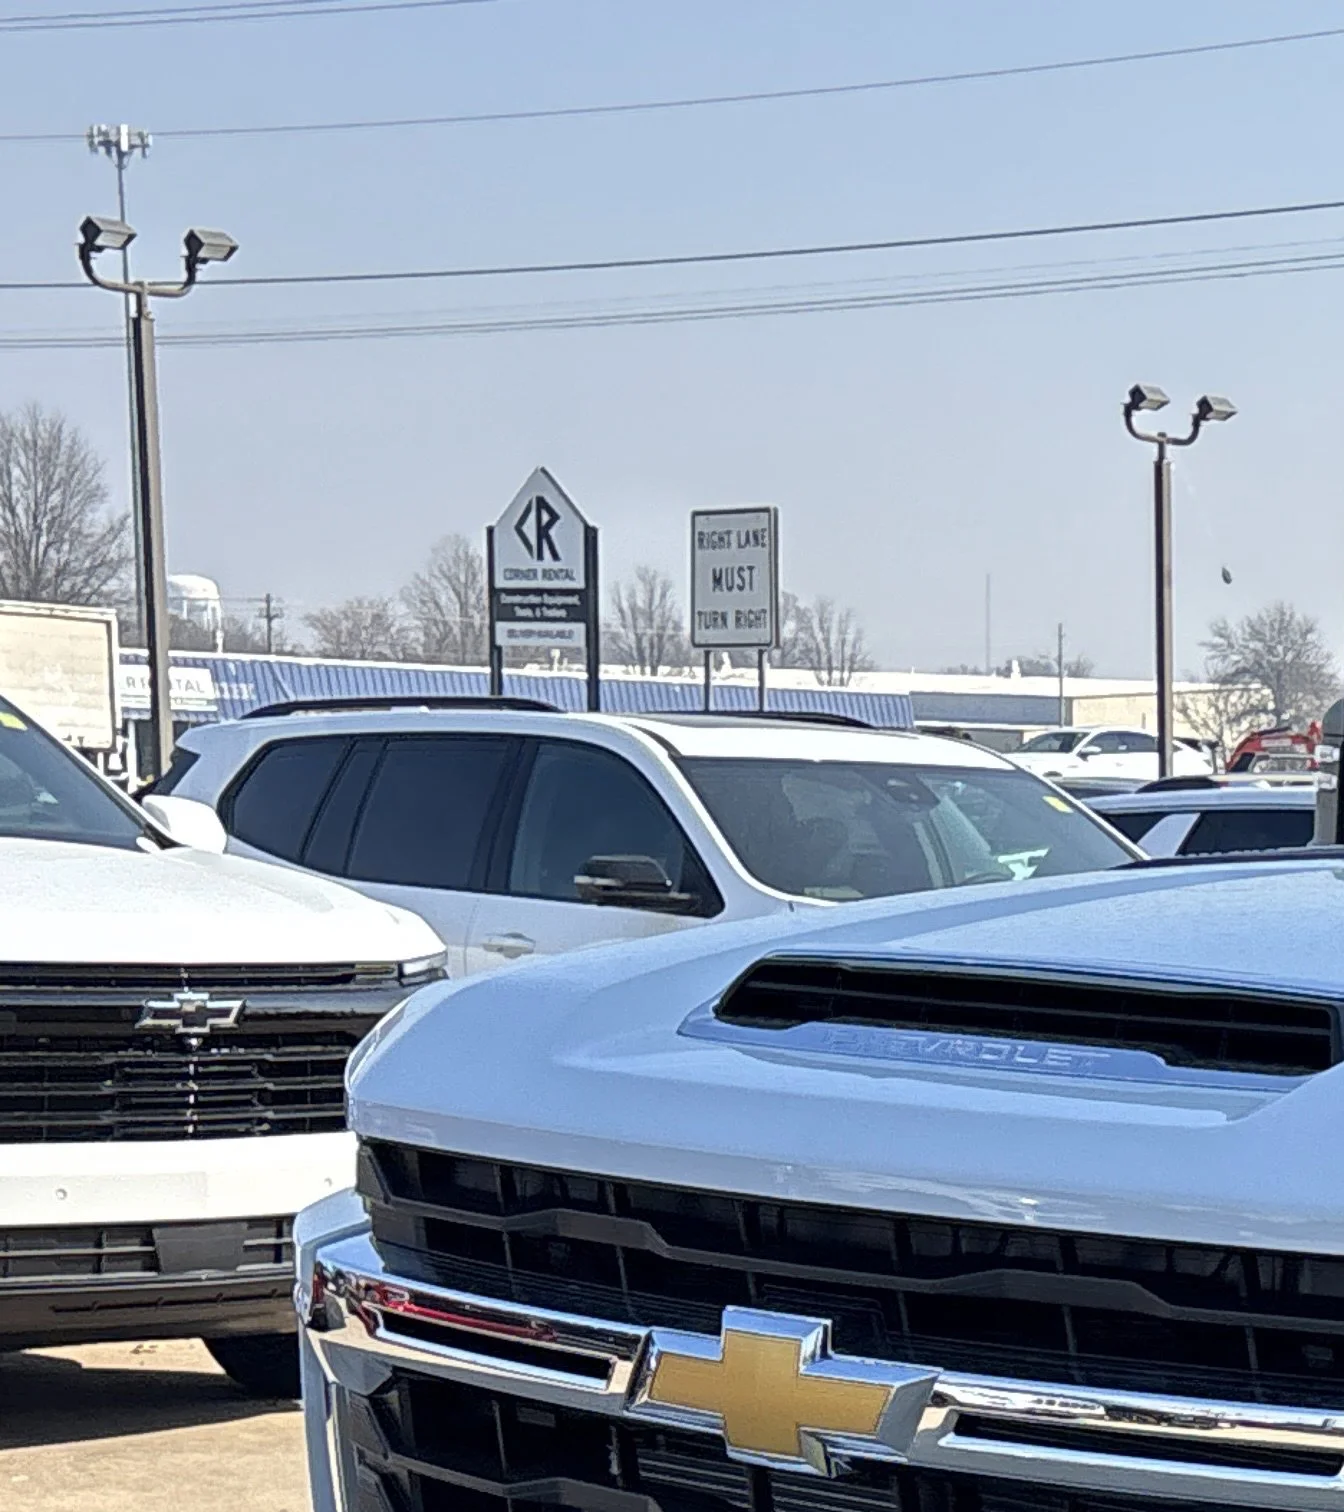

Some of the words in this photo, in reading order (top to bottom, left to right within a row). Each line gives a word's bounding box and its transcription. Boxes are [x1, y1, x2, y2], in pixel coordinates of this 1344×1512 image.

[698, 530, 732, 550] RIGHT
[736, 528, 767, 549] LANE
[712, 565, 755, 592] MUST
[697, 610, 728, 630] TURN
[735, 608, 767, 629] RIGHT
